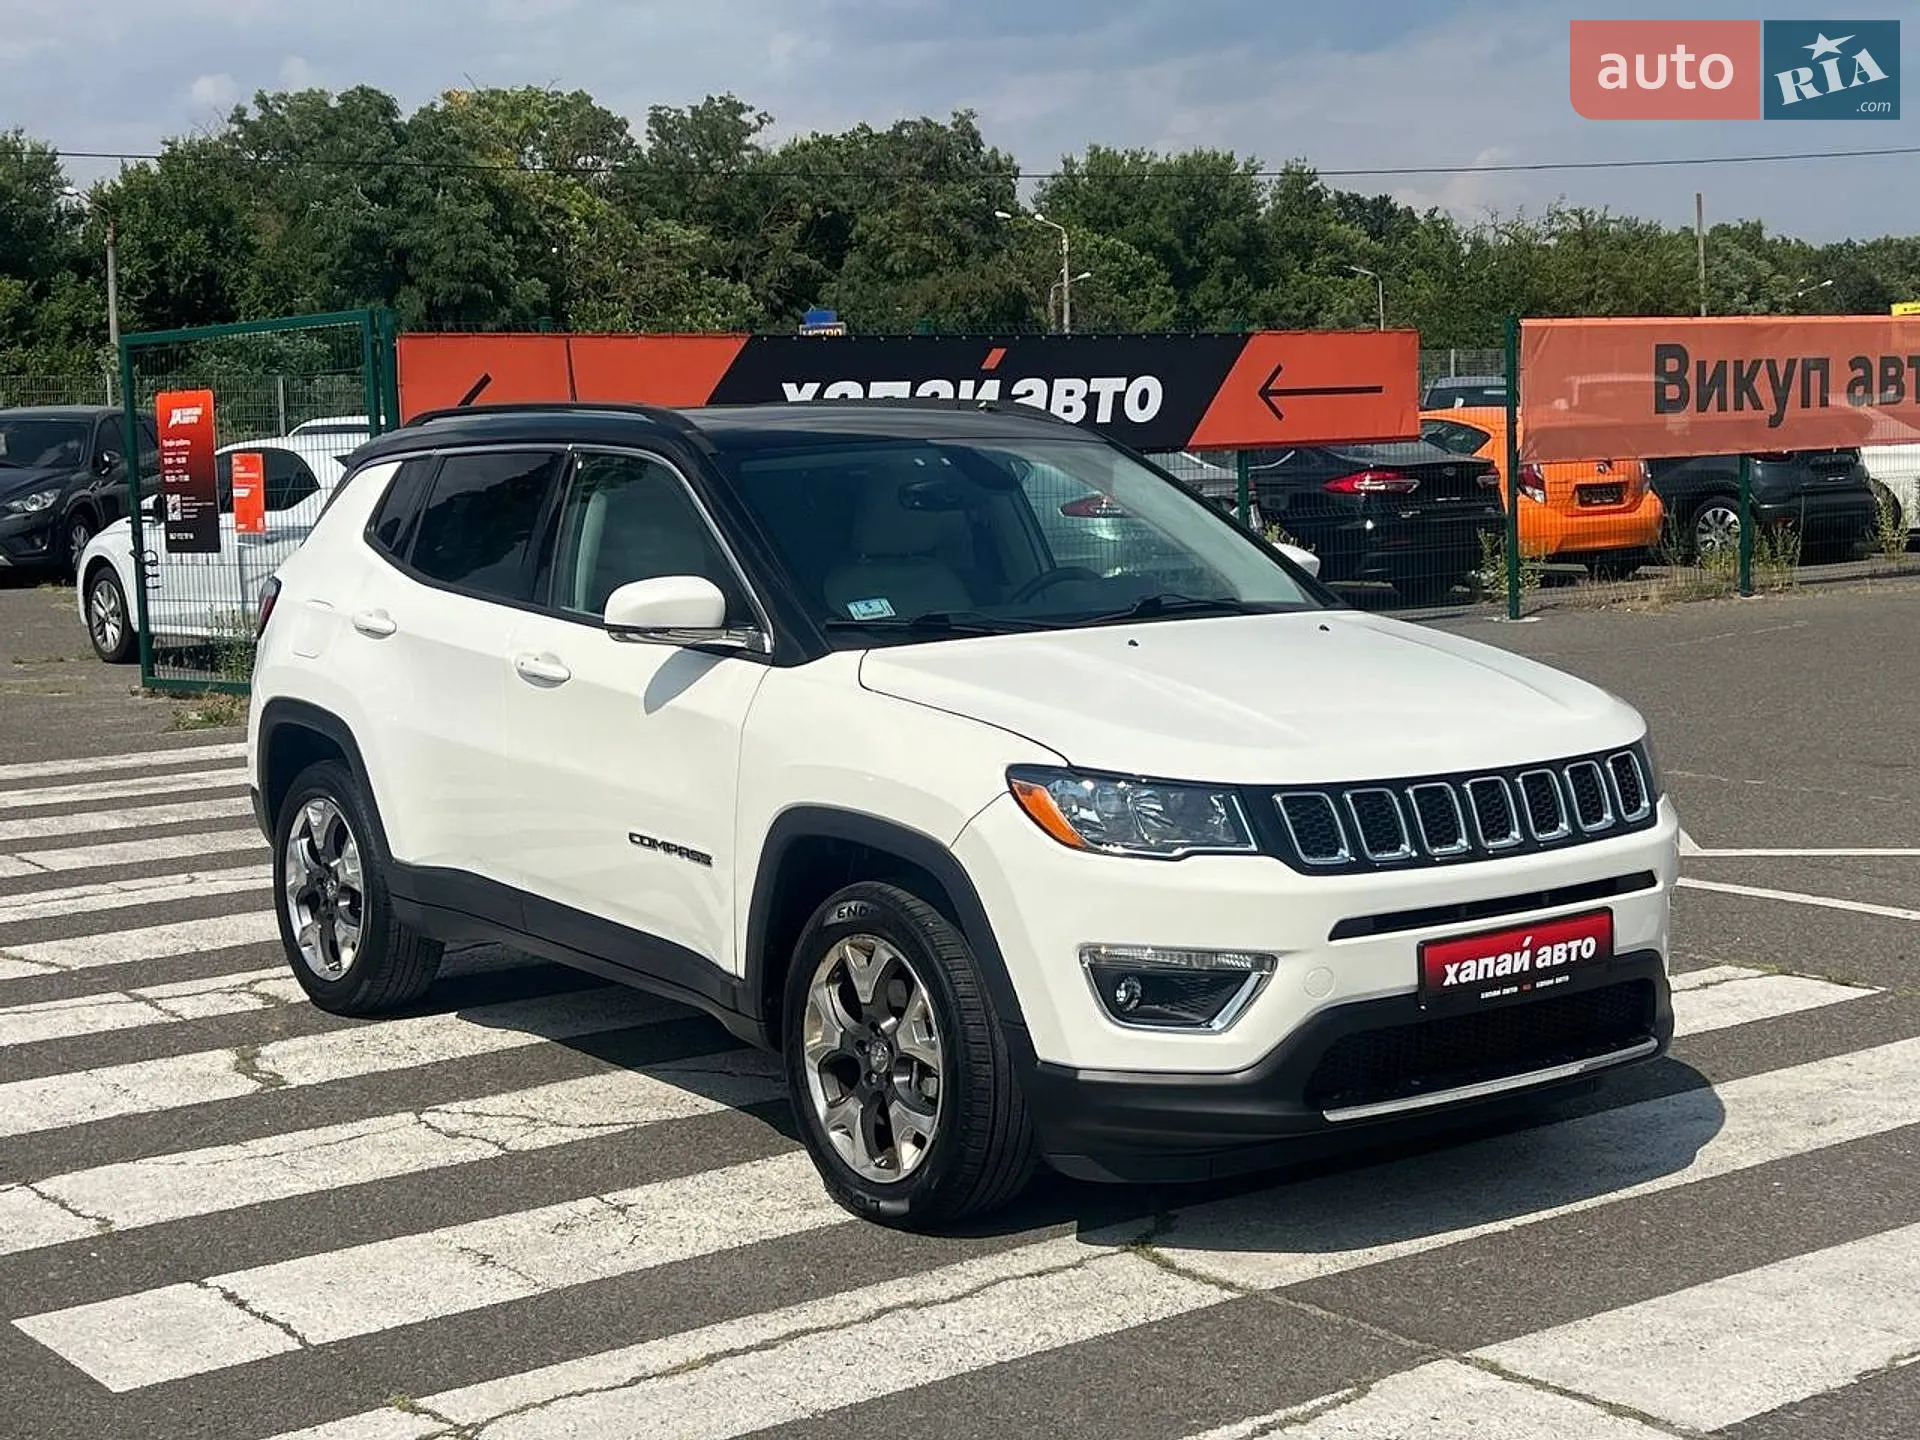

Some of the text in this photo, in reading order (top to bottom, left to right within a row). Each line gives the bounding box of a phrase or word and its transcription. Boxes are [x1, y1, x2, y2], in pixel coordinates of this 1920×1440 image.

[1010, 375, 1164, 424] авто
[1654, 343, 1831, 429] Викуп
[628, 832, 713, 867] COMPASS
[1442, 936, 1597, 988] хапай авто
